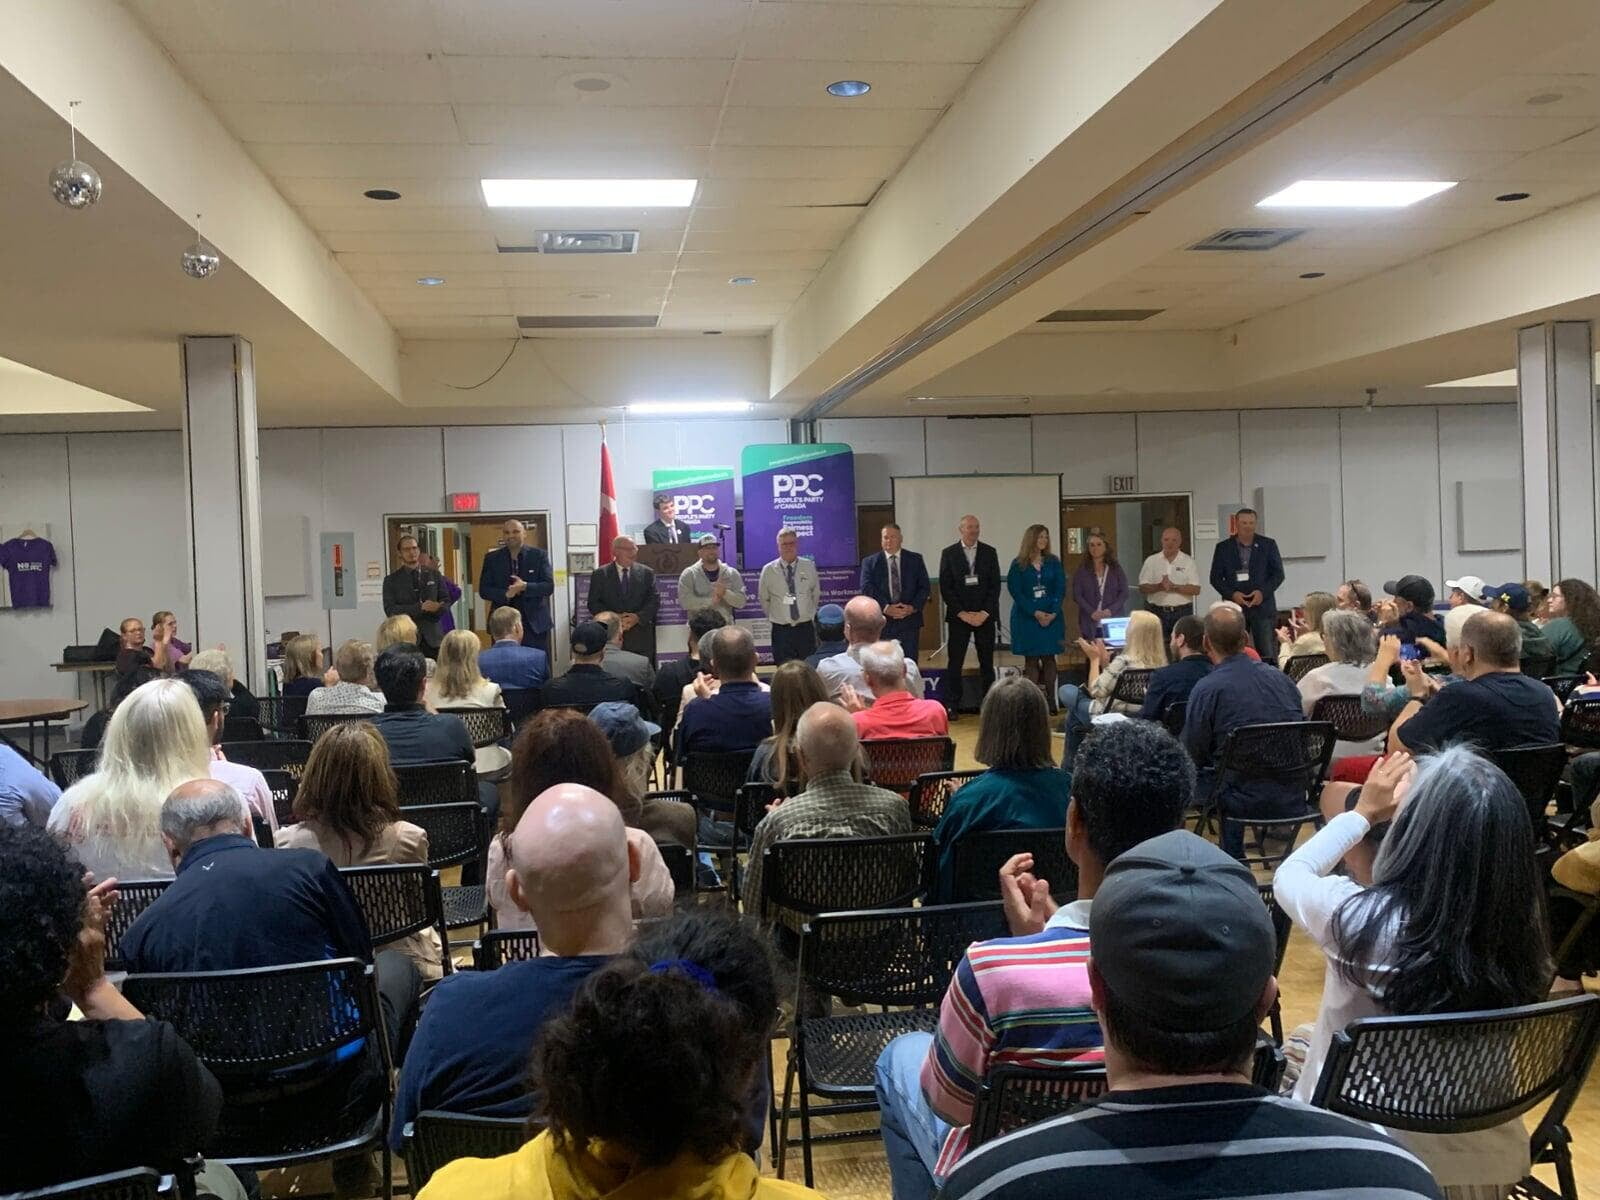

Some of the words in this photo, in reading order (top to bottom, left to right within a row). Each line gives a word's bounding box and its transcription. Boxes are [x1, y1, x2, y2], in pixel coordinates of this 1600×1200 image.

[772, 474, 824, 497] PPC
[1113, 476, 1133, 491] EXIT
[674, 494, 715, 514] PPC
